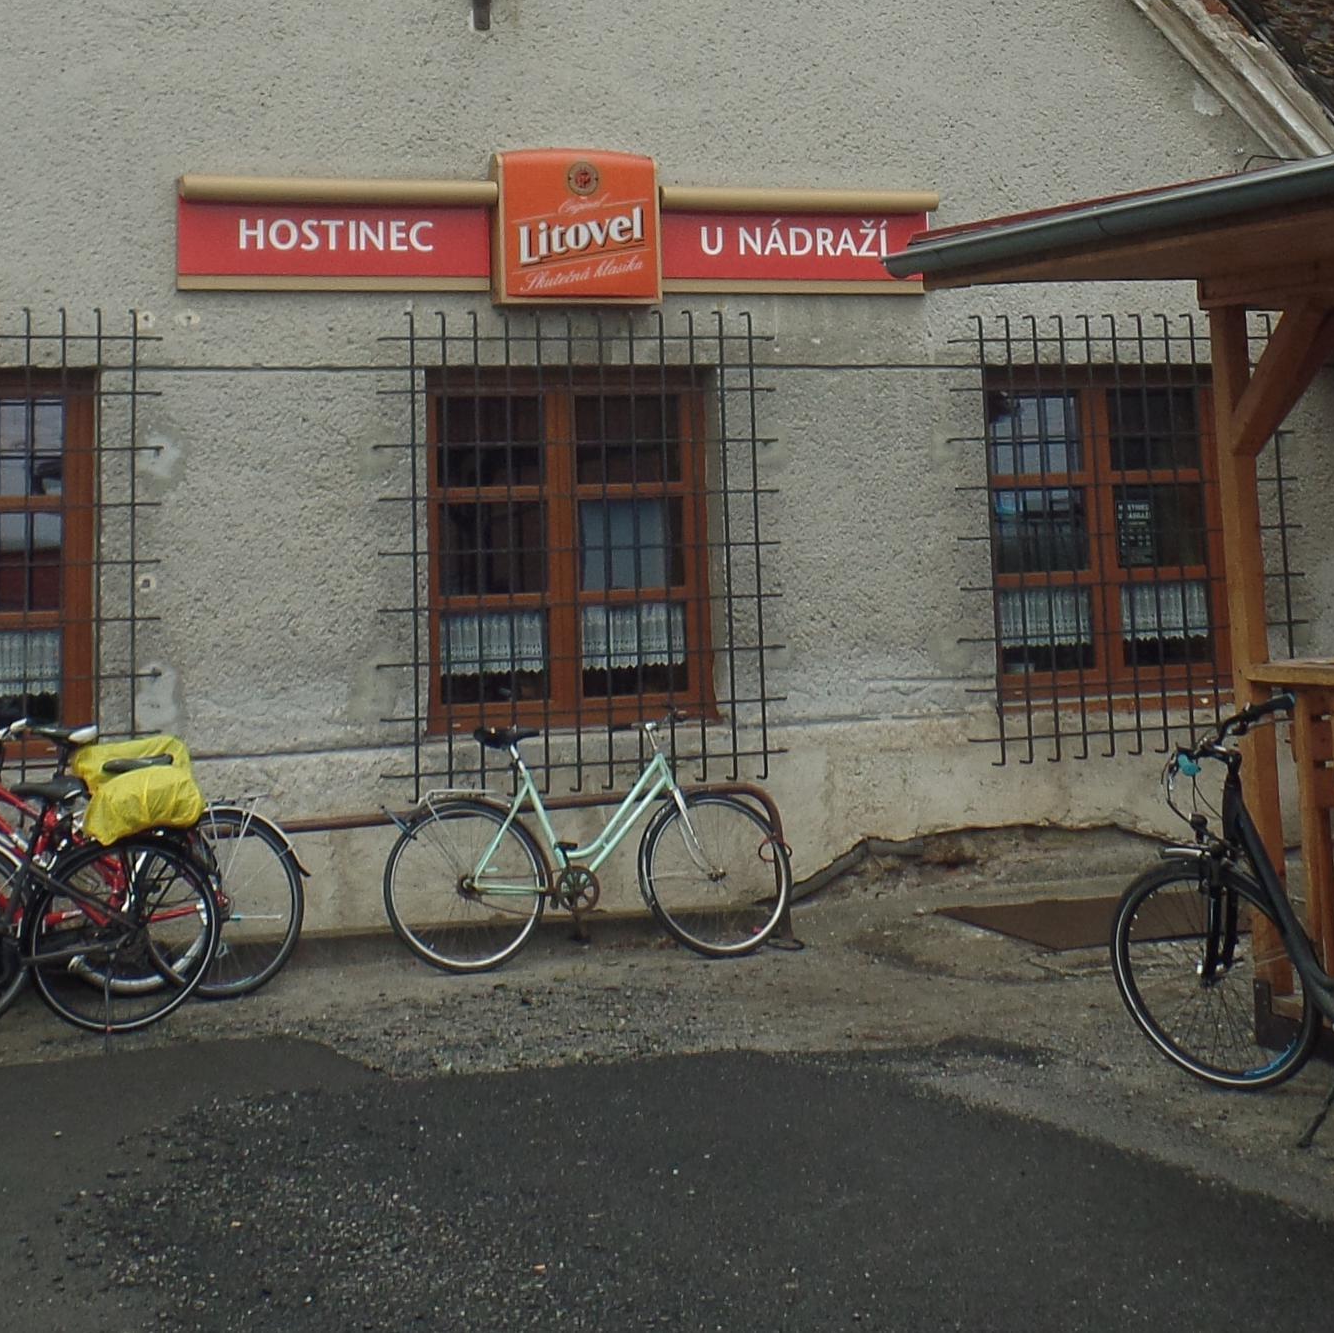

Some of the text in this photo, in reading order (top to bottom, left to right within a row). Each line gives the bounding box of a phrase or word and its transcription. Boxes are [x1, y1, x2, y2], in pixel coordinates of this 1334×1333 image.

[238, 218, 434, 252] HOSTINEC
[518, 205, 645, 267] Litovel
[700, 218, 889, 258] U NÁDRAŽÍ
